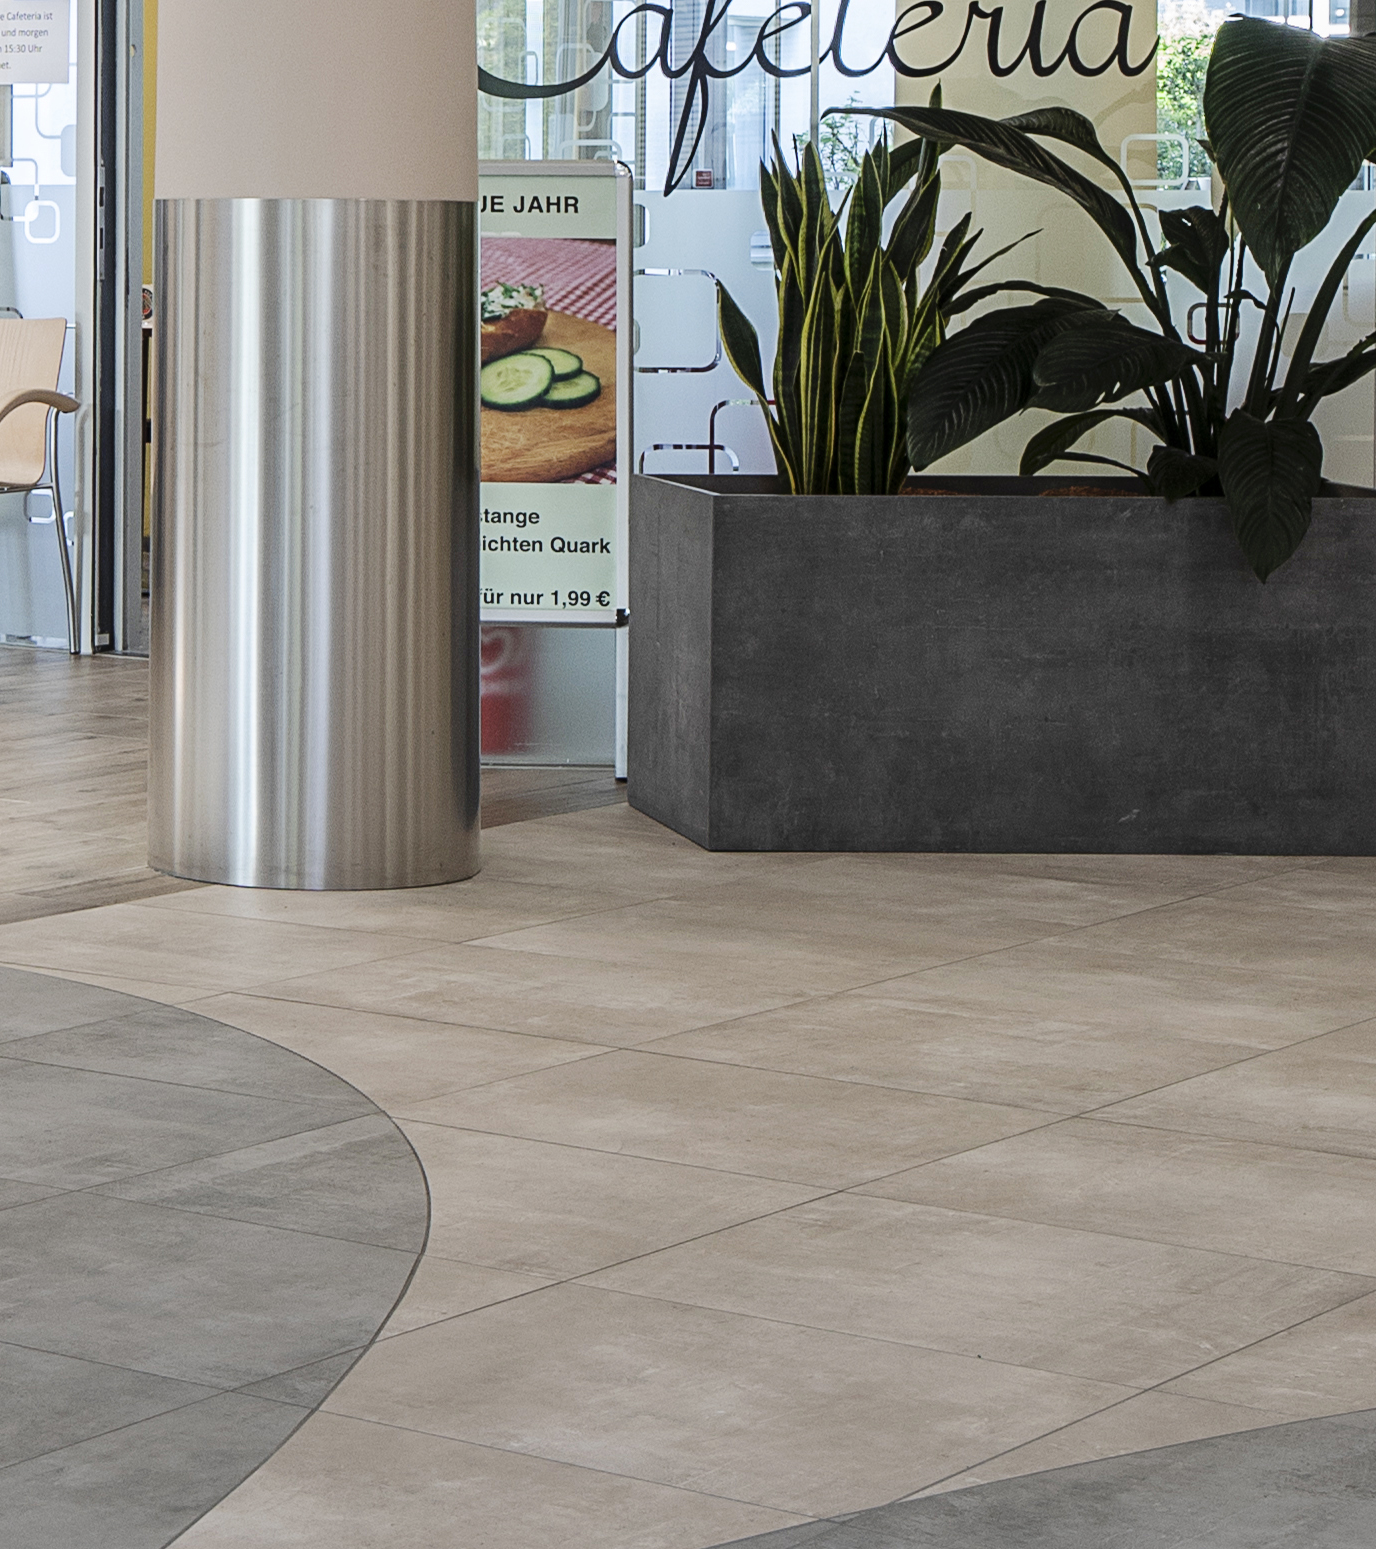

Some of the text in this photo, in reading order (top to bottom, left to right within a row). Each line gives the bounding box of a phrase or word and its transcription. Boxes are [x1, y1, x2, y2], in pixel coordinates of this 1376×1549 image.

[6, 12, 41, 21] Cafeteria
[43, 12, 53, 20] ist
[1, 28, 17, 36] und
[18, 30, 49, 38] morgen
[5, 44, 26, 53] 15:30
[27, 44, 43, 53] Uhr
[513, 196, 579, 214] JAHR
[550, 537, 611, 554] Quark
[511, 592, 544, 605] nur
[551, 590, 591, 609] 1,99
[596, 591, 611, 607] €
